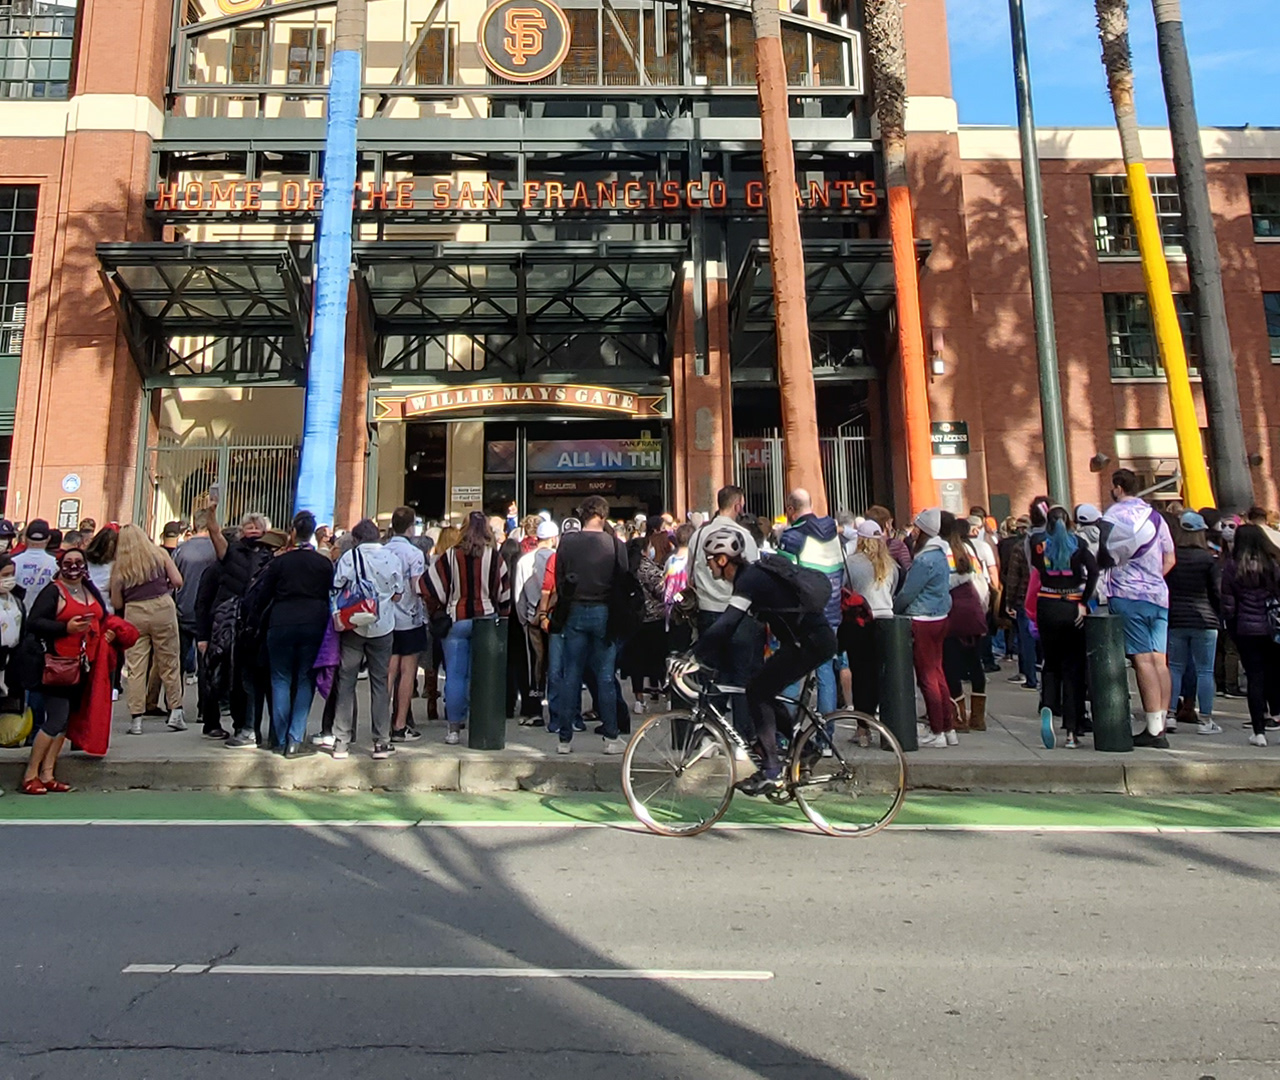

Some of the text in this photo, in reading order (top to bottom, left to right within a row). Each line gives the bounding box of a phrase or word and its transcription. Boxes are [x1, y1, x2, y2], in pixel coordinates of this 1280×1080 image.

[156, 181, 262, 210] HOME
[282, 181, 325, 210] OF
[433, 181, 505, 209] SAN
[522, 181, 727, 209] FRANCISCO
[745, 181, 878, 208] GNTS
[410, 387, 634, 410] WILLIE MAYS GATE
[557, 452, 596, 468] ALL
[602, 451, 622, 467] IN
